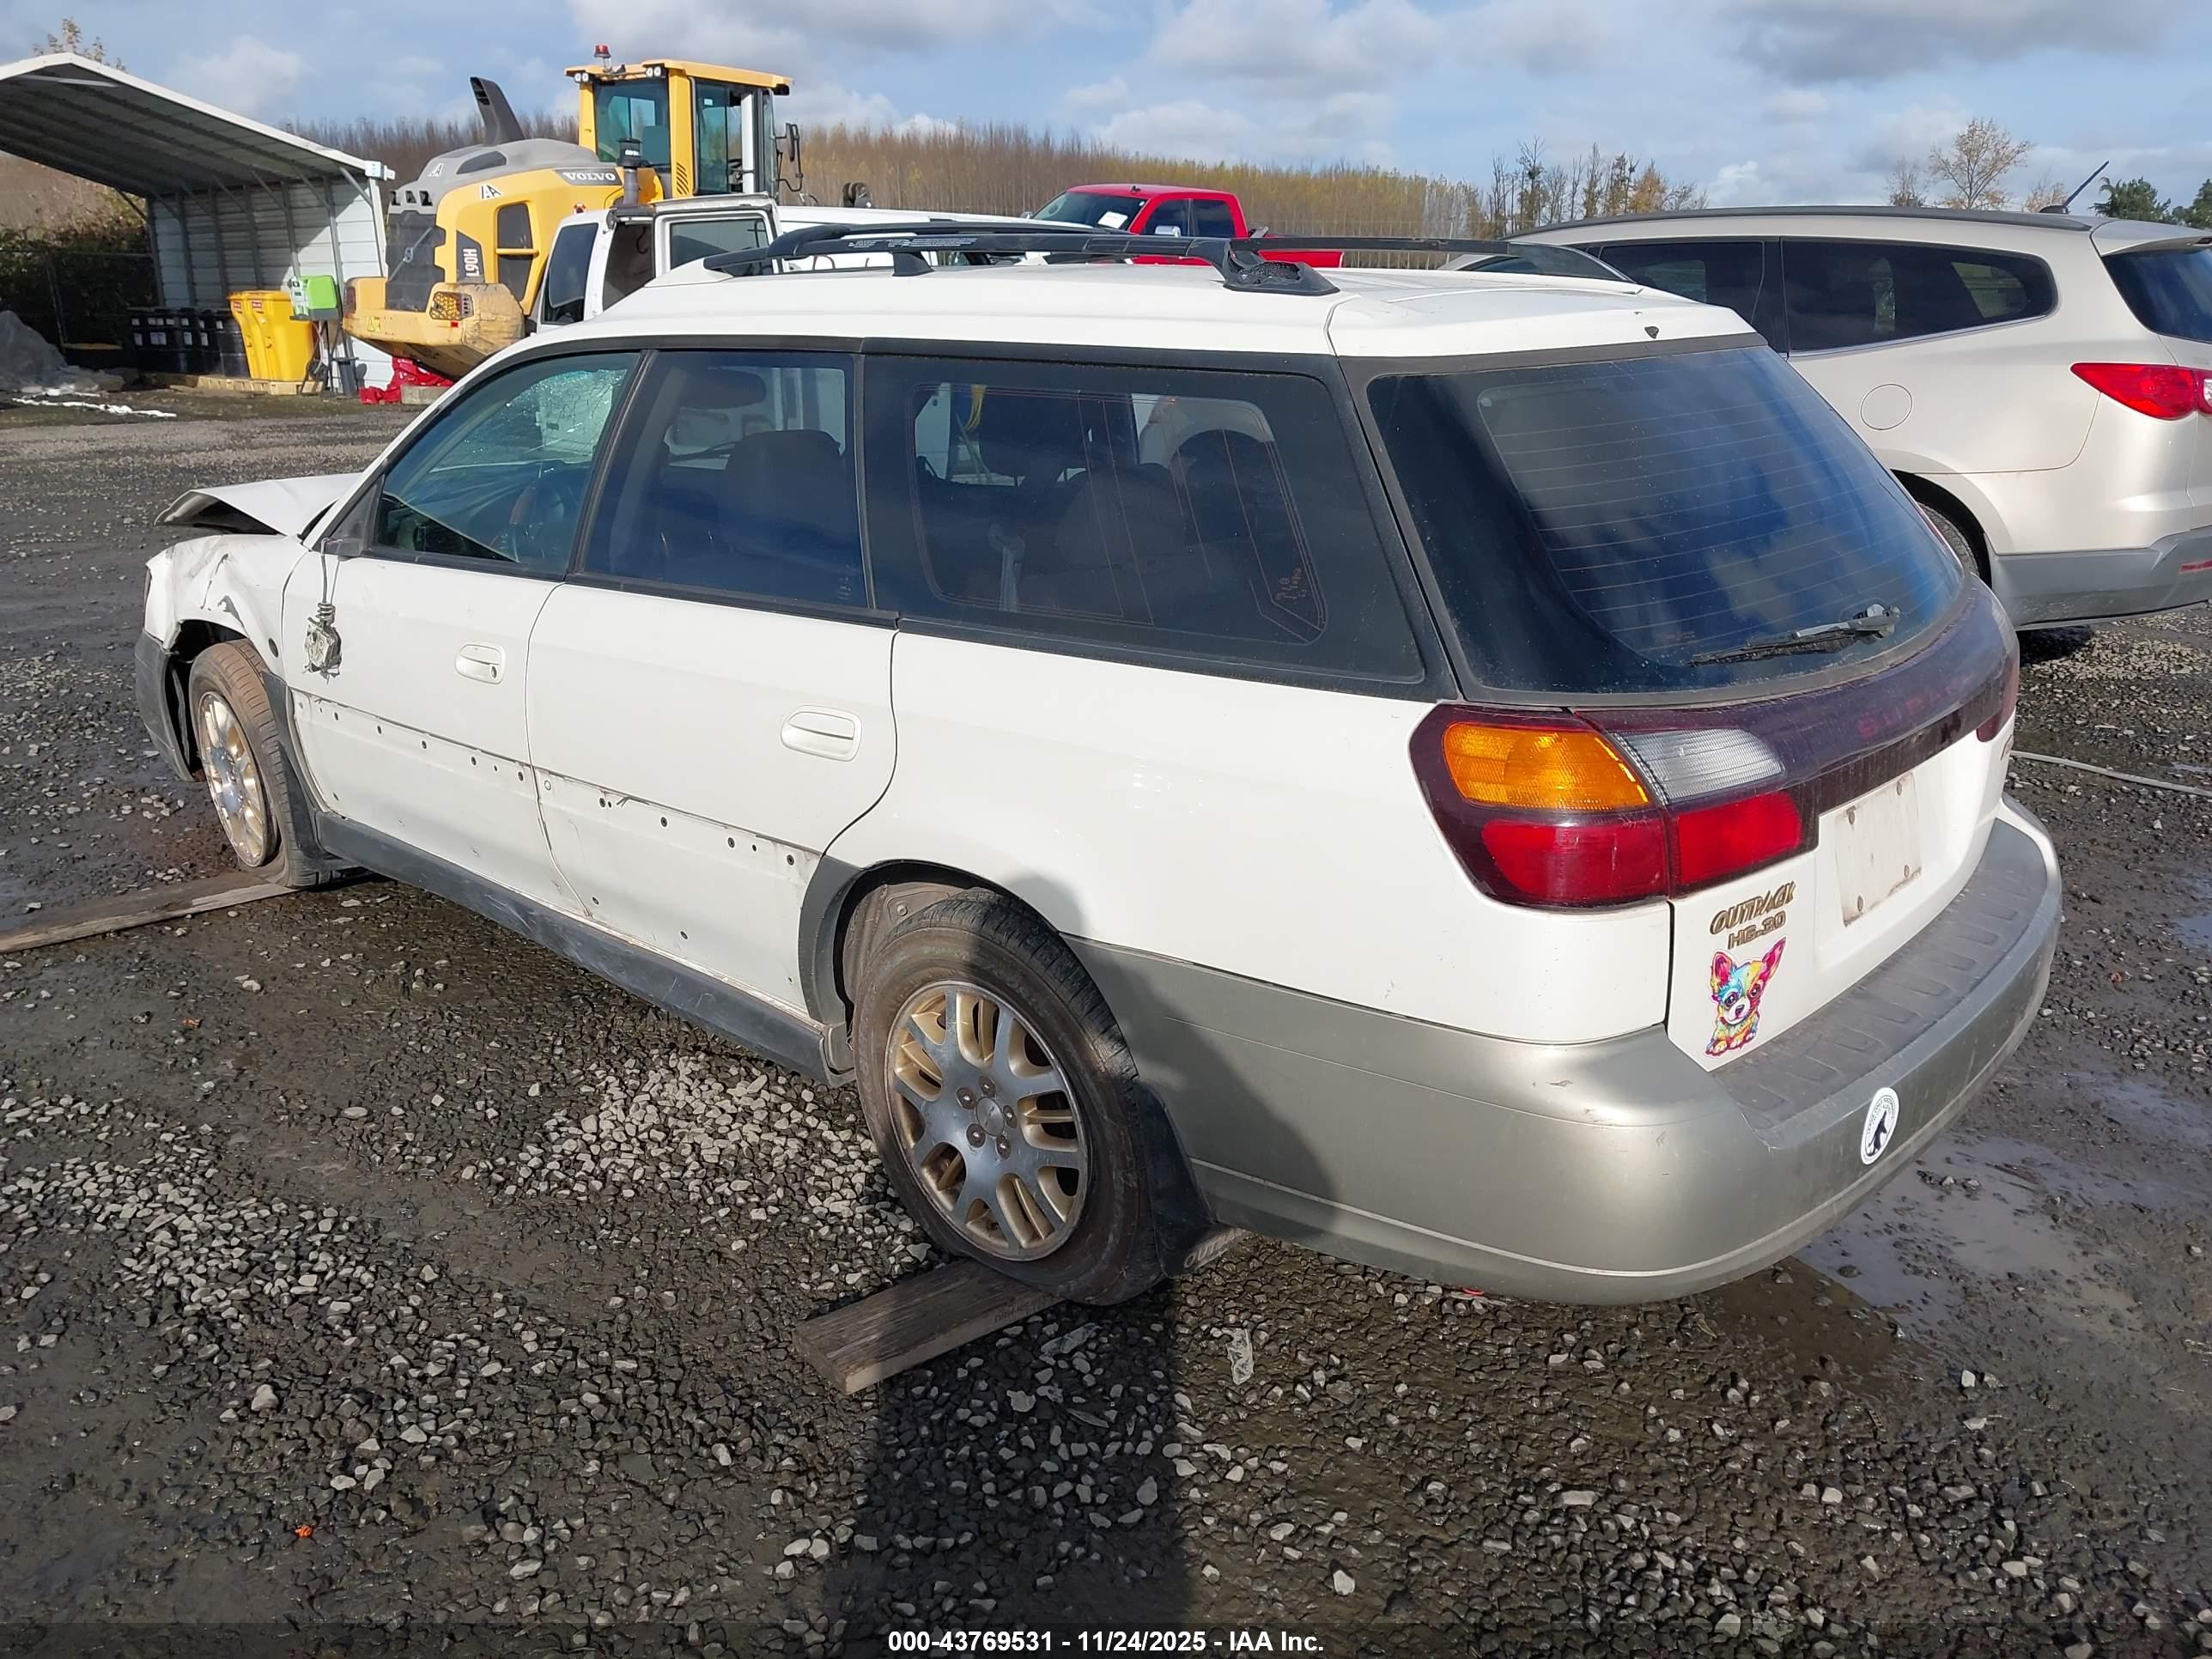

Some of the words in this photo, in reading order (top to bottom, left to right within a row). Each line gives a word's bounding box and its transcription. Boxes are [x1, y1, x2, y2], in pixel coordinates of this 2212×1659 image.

[562, 171, 617, 181] VOLVO
[462, 248, 480, 277] L90H
[1710, 881, 1796, 935] OUTBACK
